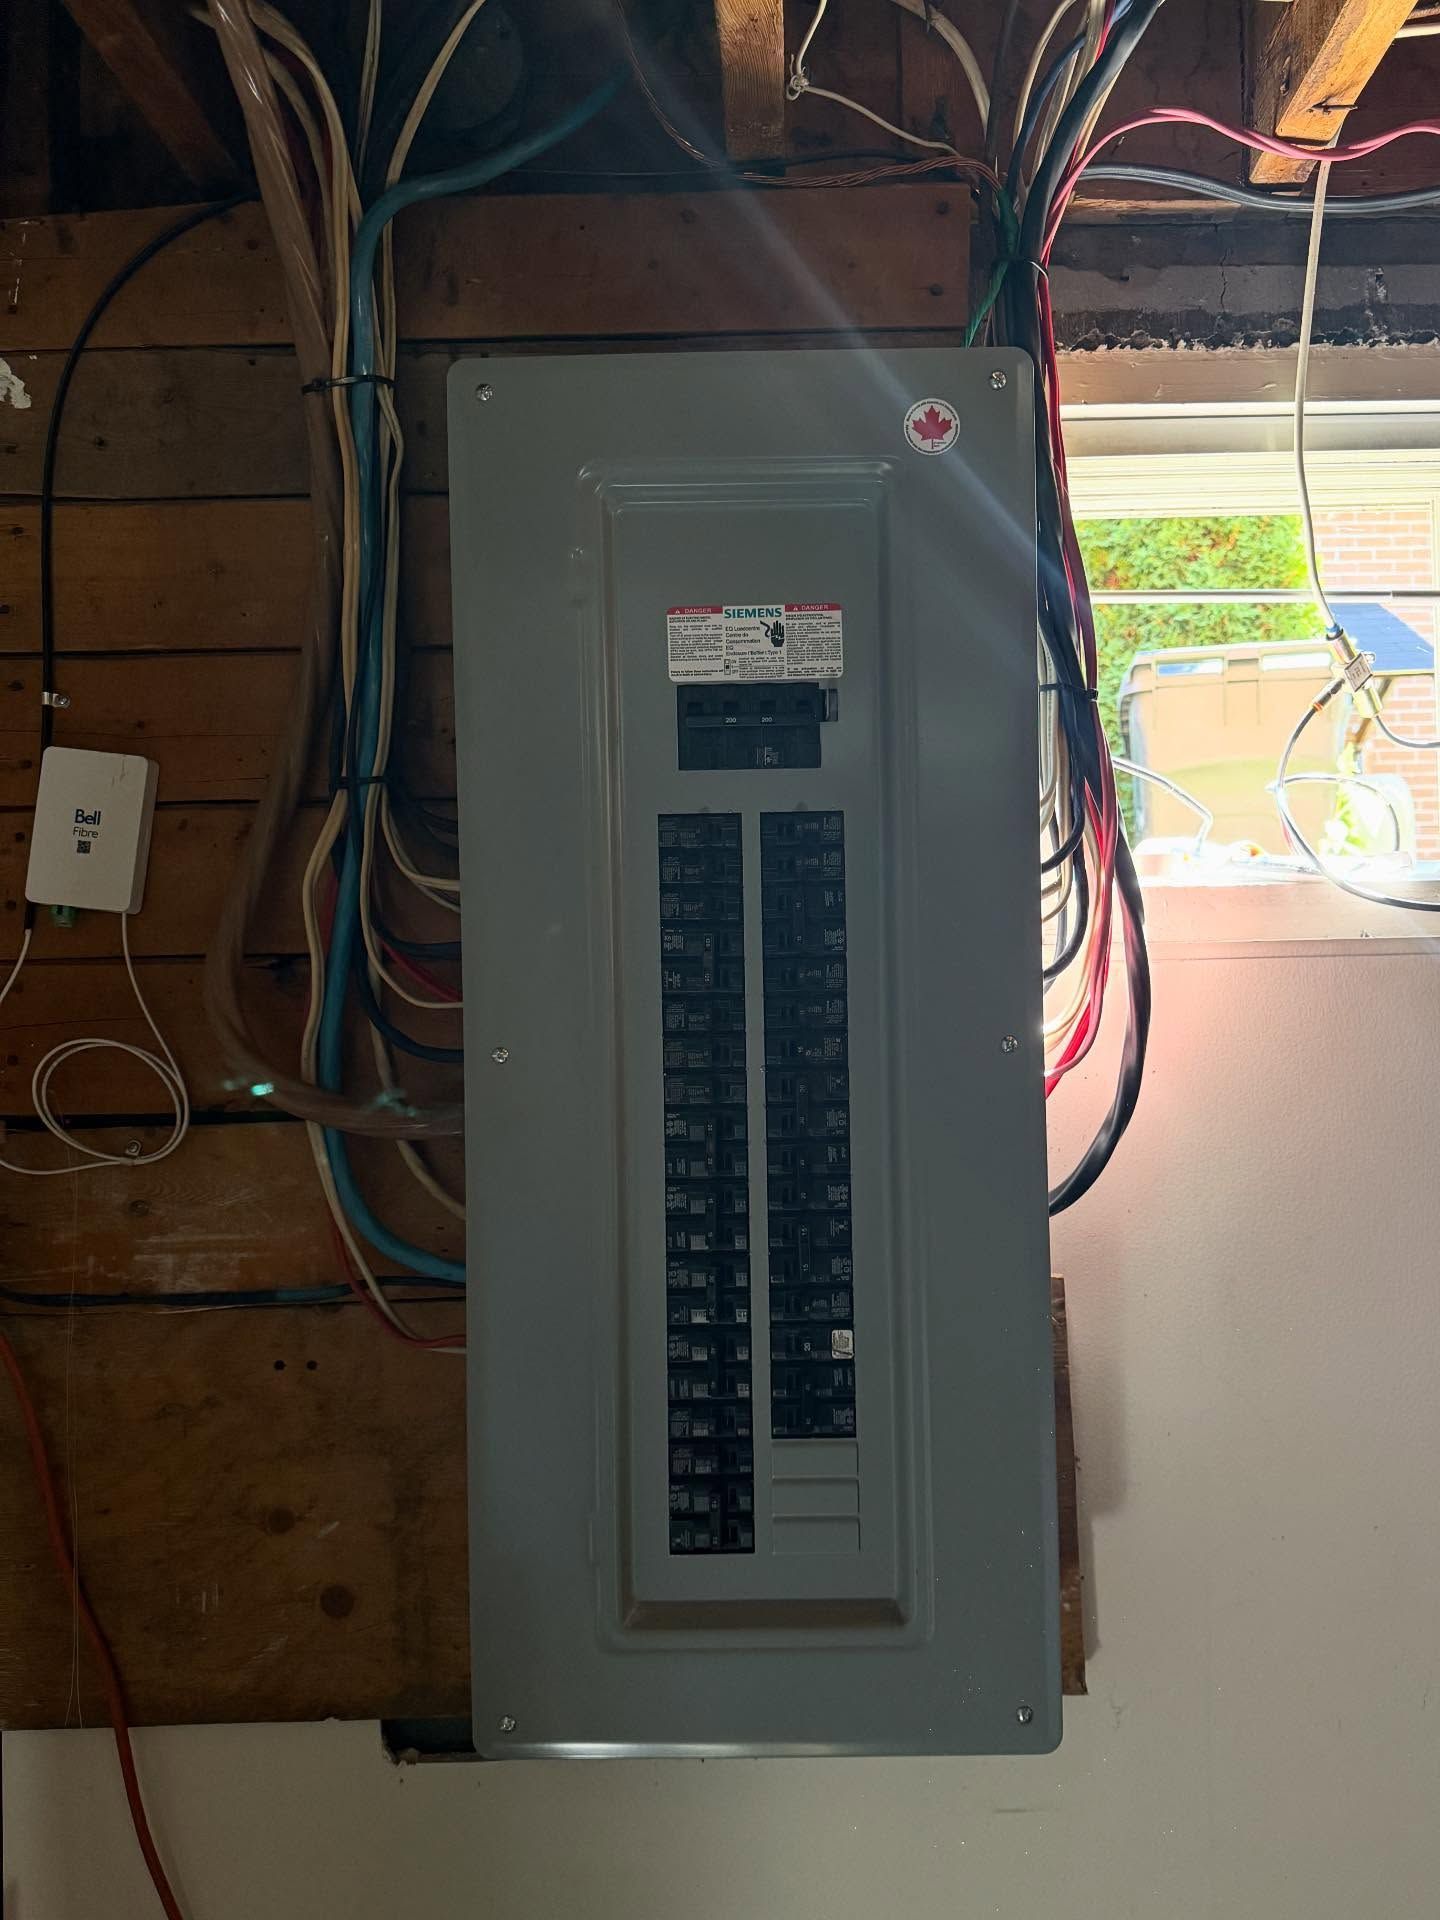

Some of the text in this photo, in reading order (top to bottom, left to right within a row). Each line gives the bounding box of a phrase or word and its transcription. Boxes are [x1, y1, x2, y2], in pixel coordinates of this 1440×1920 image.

[724, 607, 782, 619] SIEMENS
[75, 808, 102, 826] Bell
[73, 826, 98, 839] Fibre
